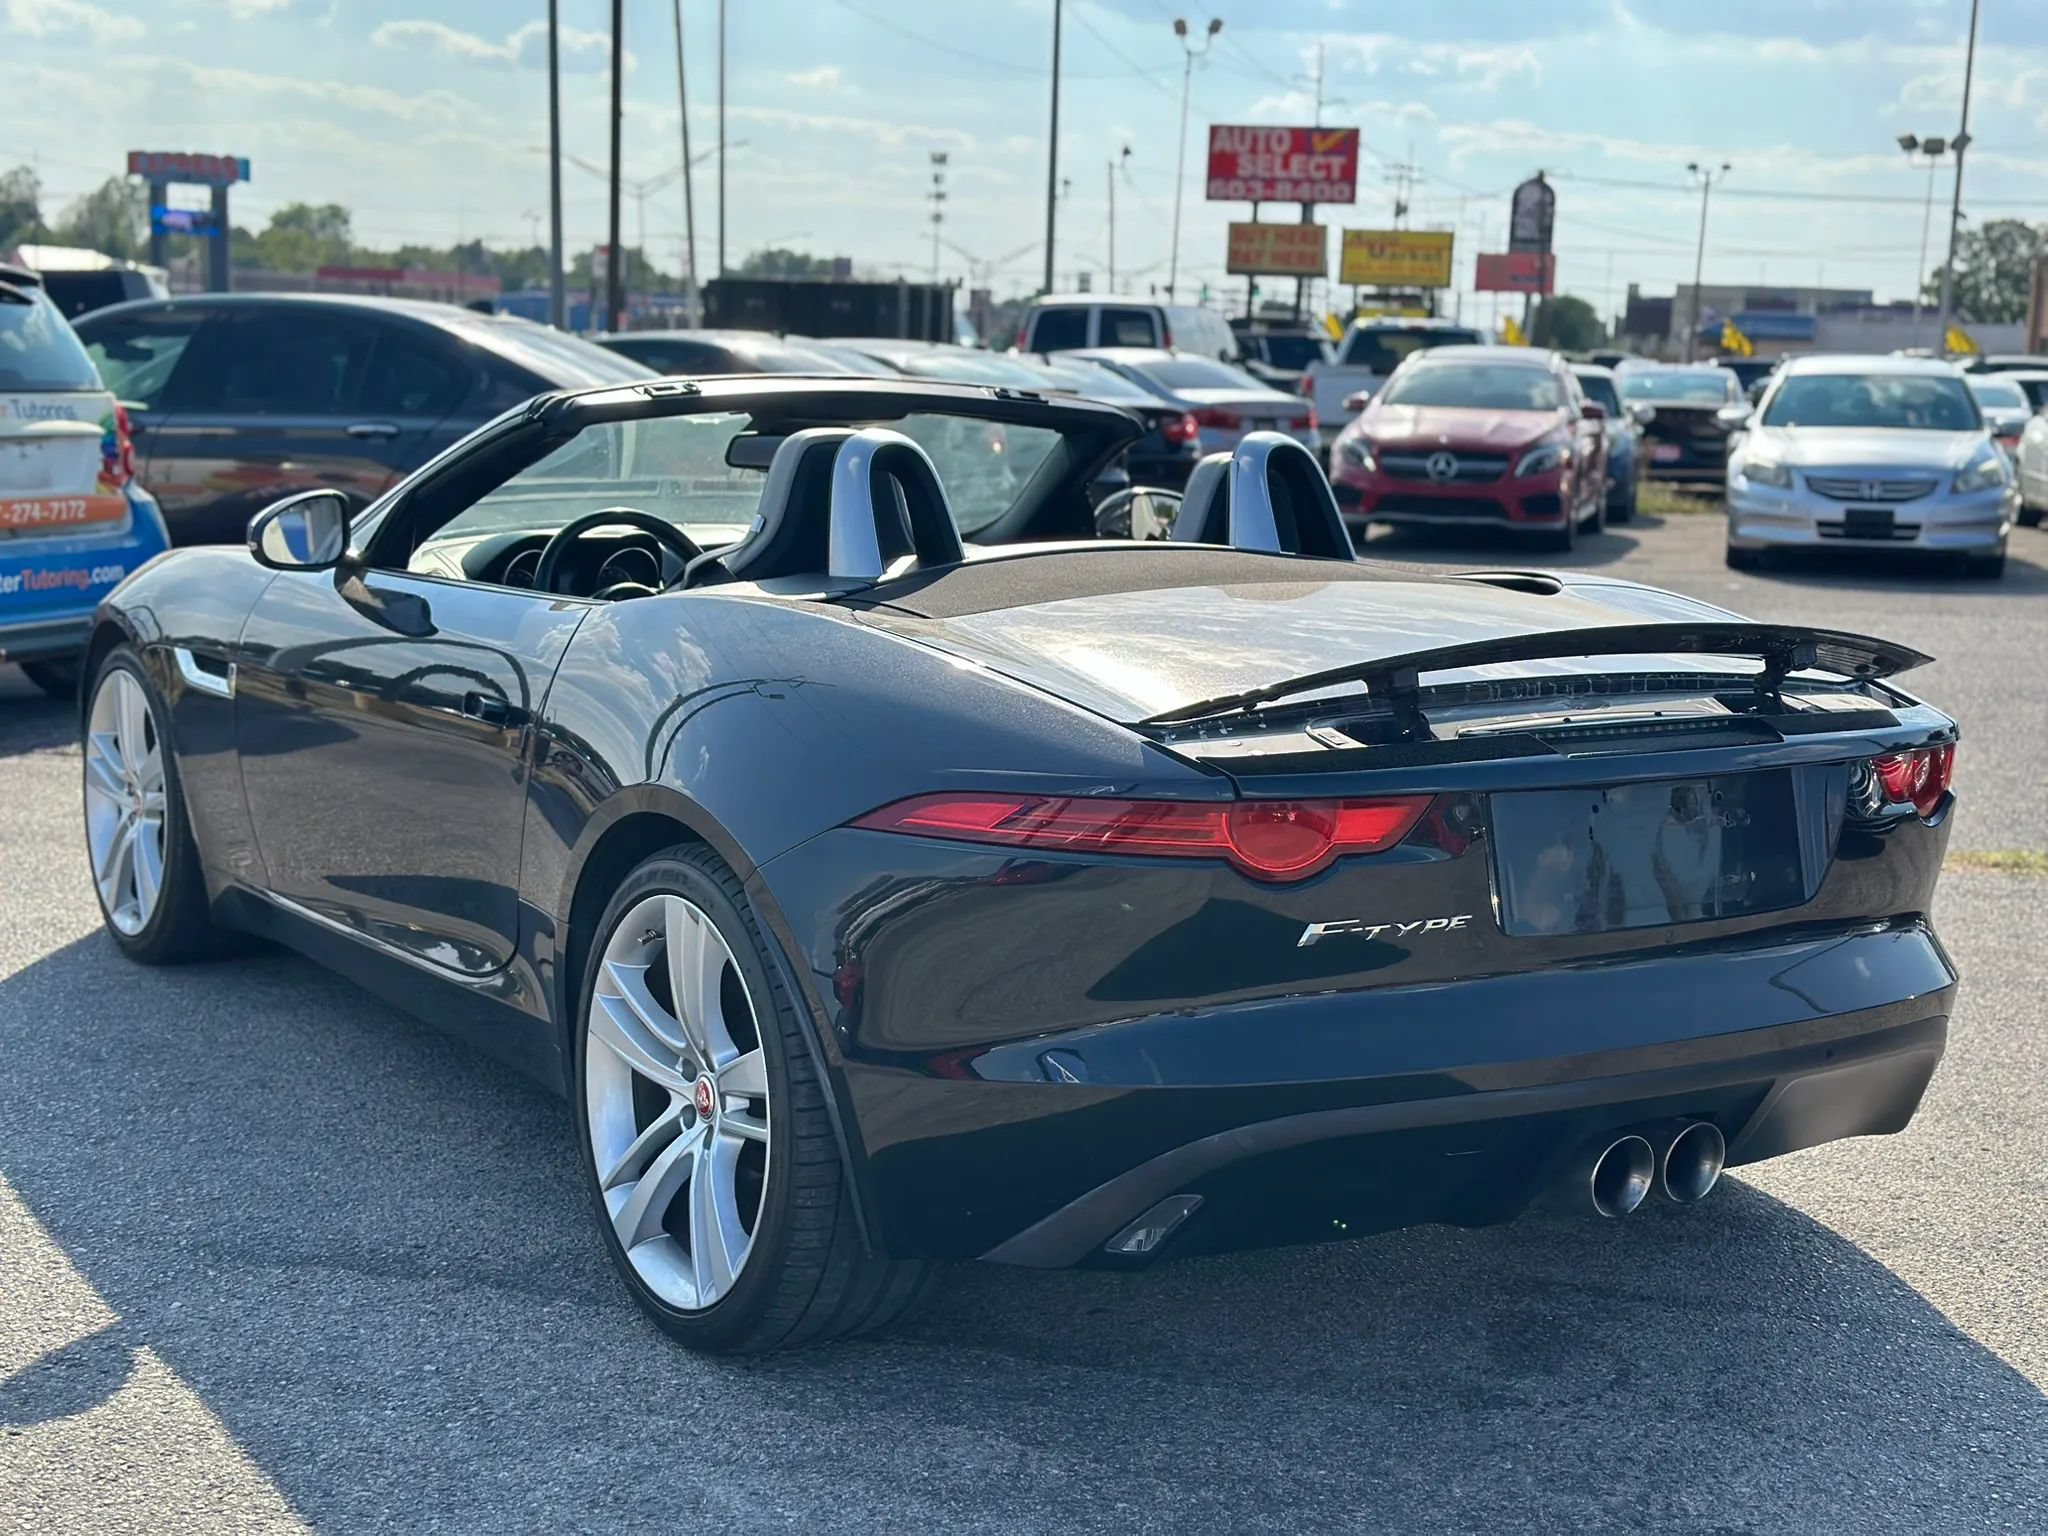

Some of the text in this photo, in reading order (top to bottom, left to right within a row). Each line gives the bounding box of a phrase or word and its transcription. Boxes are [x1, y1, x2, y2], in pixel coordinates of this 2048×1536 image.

[1212, 127, 1292, 154] AUTO
[1236, 154, 1347, 180] SELECT
[1208, 179, 1352, 202] 603-8400
[0, 500, 87, 524] -274-7172
[1297, 915, 1473, 947] F-TYPE
